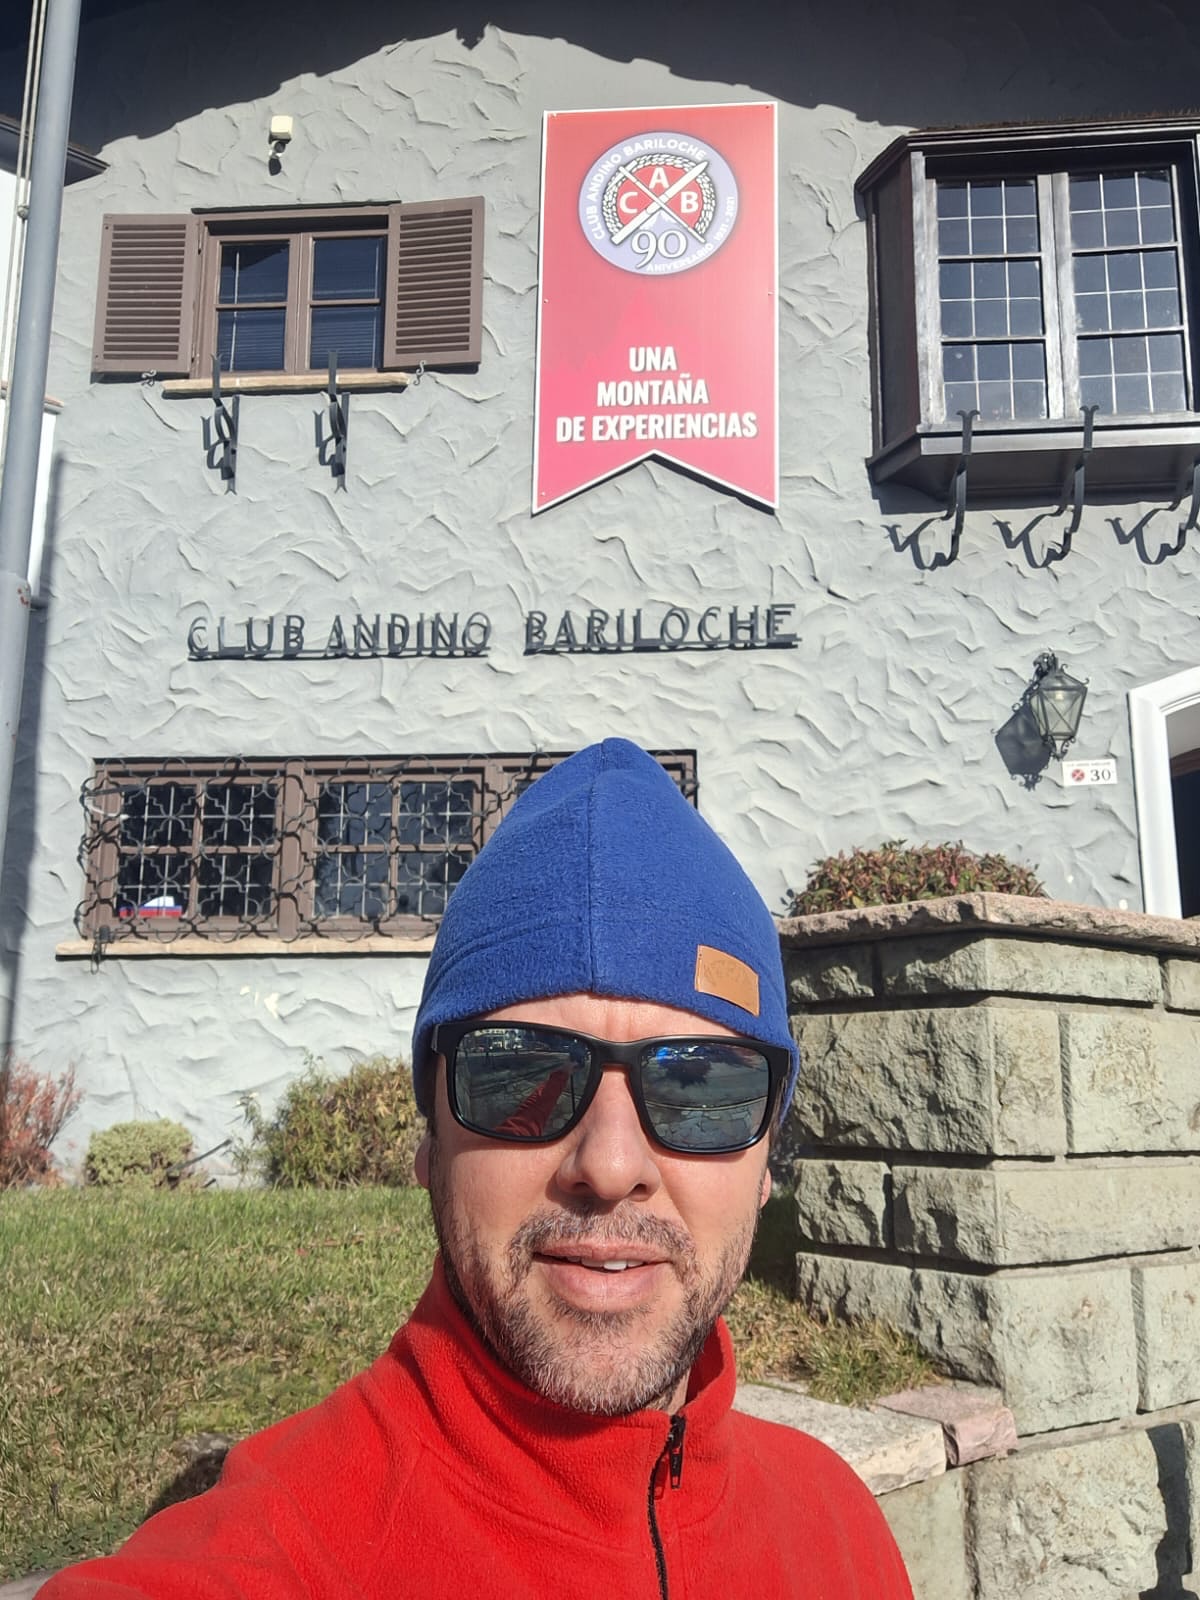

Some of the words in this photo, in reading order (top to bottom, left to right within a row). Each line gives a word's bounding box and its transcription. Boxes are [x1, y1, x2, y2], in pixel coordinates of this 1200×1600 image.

[623, 138, 707, 160] BARILOCHE
[587, 153, 622, 202] ANDINO
[619, 191, 638, 214] C
[649, 167, 669, 189] A
[681, 191, 699, 214] B
[586, 206, 606, 240] CLUB
[631, 229, 688, 269] 90
[629, 346, 677, 372] UNA
[597, 373, 709, 407] MONTAÑA
[556, 416, 586, 442] DE
[592, 412, 758, 441] EXPERIENCIAS
[188, 615, 305, 653] CLUB
[326, 612, 491, 652] ANDINO
[525, 603, 798, 650] BARILOCHE
[1090, 768, 1111, 781] 30
